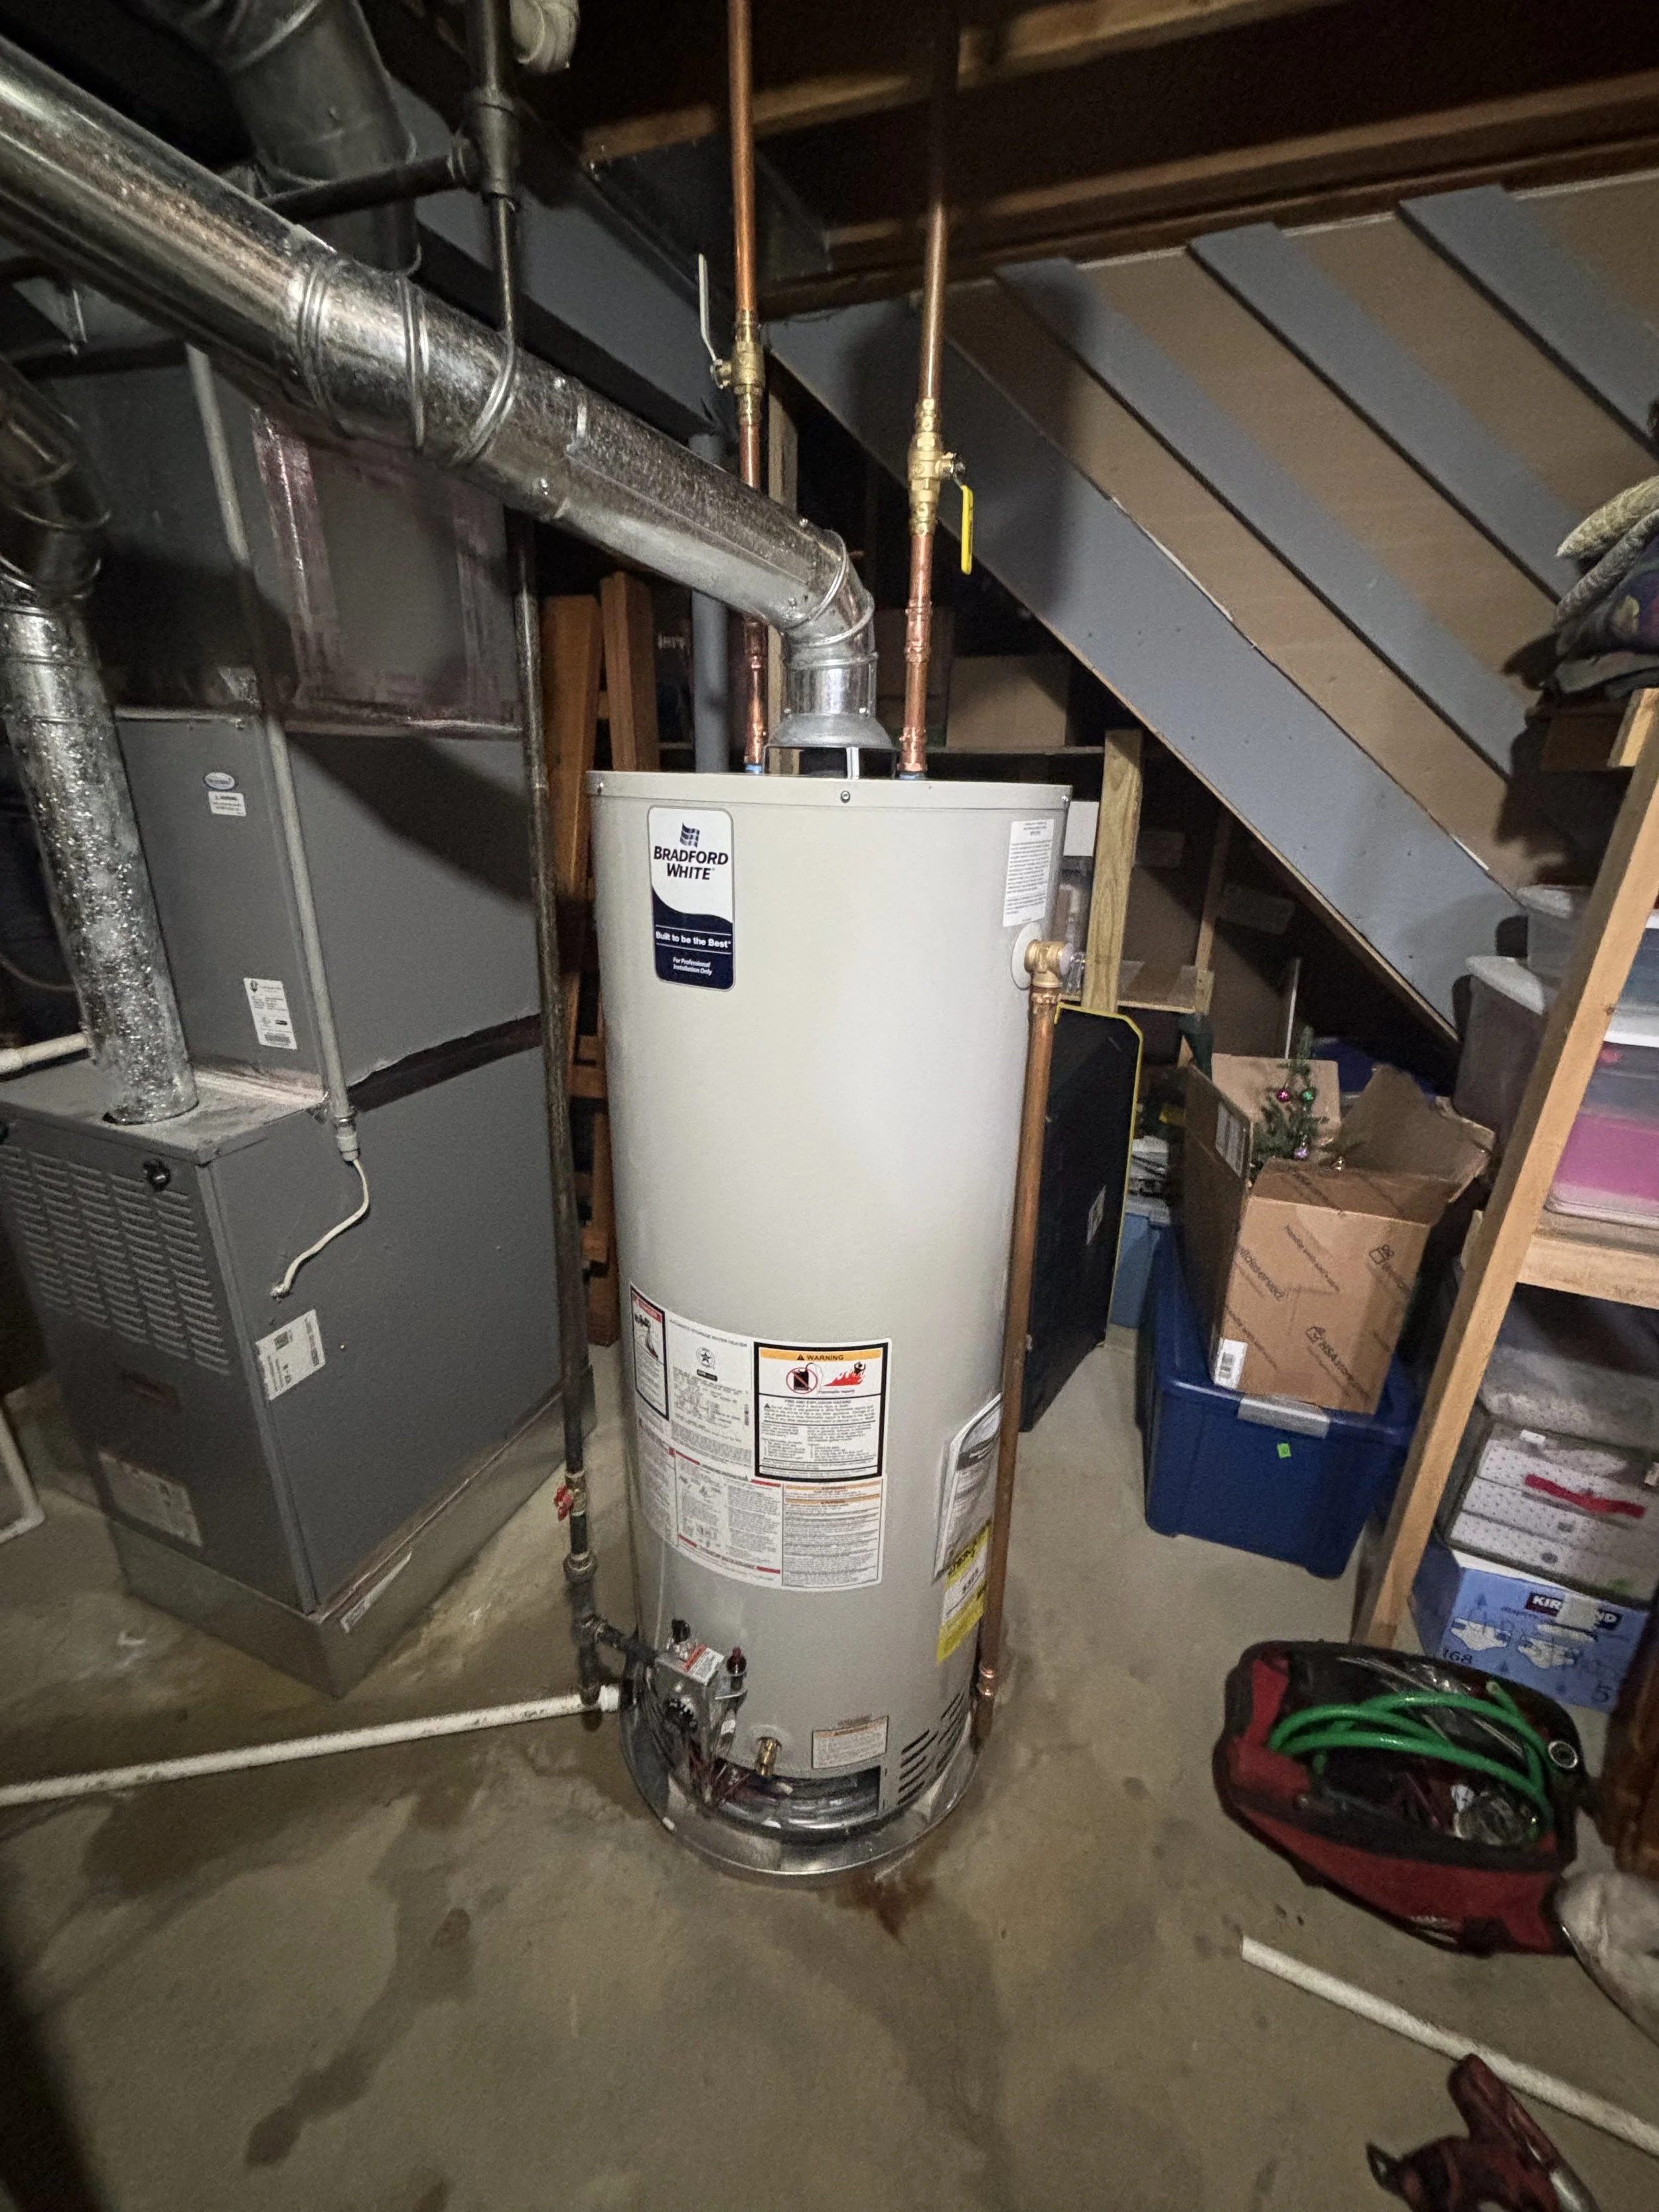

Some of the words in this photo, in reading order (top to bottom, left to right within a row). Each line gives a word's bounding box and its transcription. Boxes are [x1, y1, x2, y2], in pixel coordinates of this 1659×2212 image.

[654, 846, 729, 865] BRADFORD
[667, 863, 711, 880] WHITE
[655, 931, 671, 941] Built
[681, 935, 691, 944] be
[693, 937, 706, 946] the
[673, 964, 700, 974] Installation
[700, 968, 713, 976] Only
[681, 958, 711, 968] Professional
[1532, 1595, 1617, 1623] KIRND
